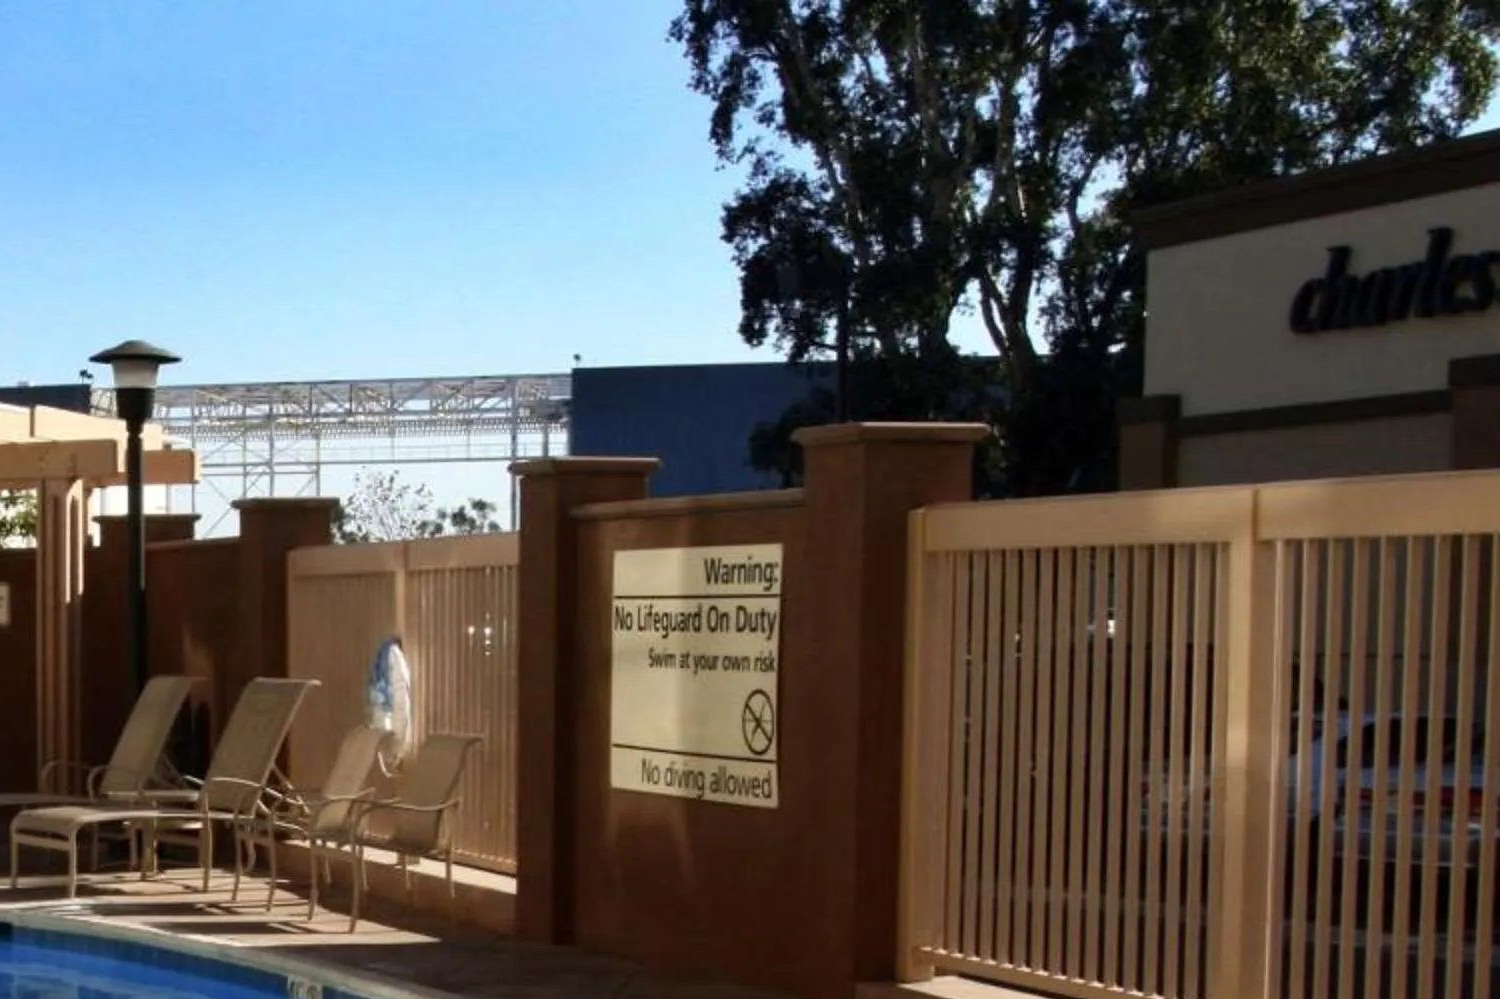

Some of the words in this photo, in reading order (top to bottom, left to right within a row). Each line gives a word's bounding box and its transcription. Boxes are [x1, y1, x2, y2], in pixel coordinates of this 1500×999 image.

[704, 557, 780, 591] Warning:
[614, 606, 633, 631] No
[637, 604, 702, 638] Lifeguard
[706, 606, 729, 632] On
[735, 606, 777, 640] Duty
[648, 648, 676, 669] Swim
[679, 652, 690, 669] at
[693, 653, 718, 675] your
[721, 654, 749, 671] own
[753, 651, 775, 673] risk
[641, 759, 660, 784] No
[663, 761, 704, 799] diving
[709, 766, 773, 799] allowed
